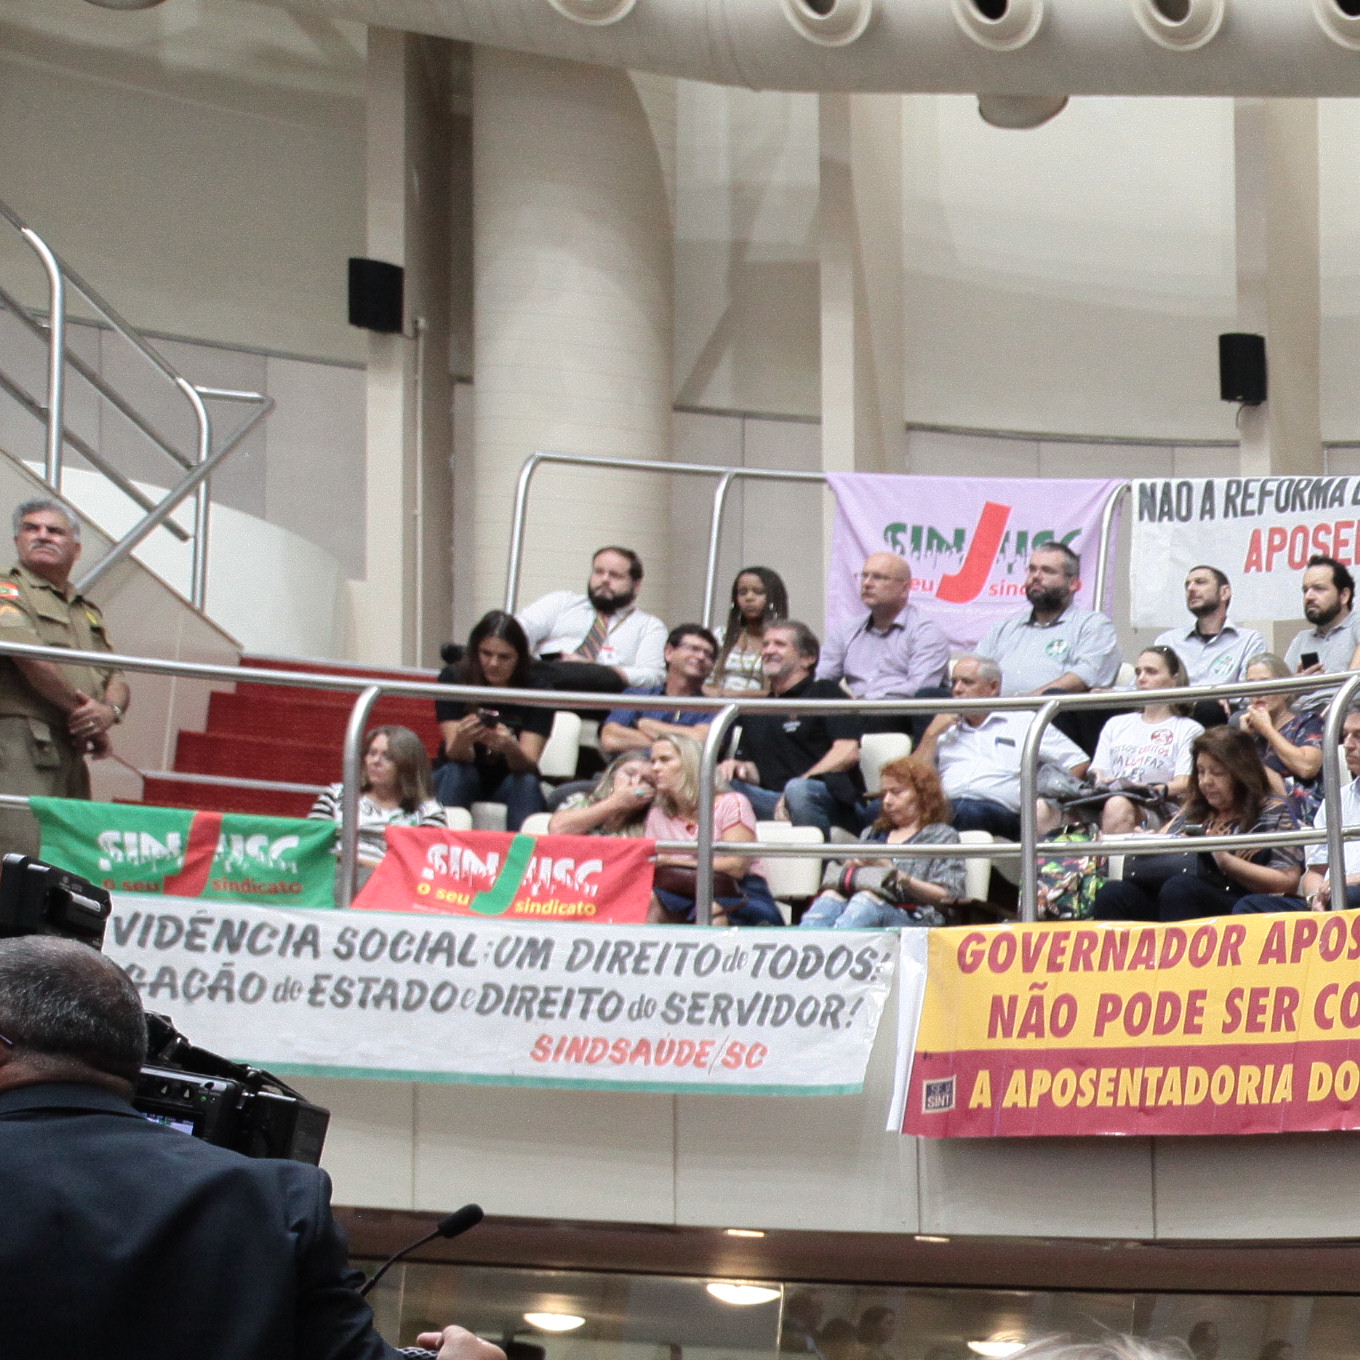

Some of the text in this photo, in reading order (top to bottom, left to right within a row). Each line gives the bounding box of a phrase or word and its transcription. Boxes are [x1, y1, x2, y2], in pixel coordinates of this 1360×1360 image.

[1199, 480, 1216, 521] A
[1223, 477, 1345, 519] REFORMA
[121, 880, 160, 892] seu
[212, 877, 303, 896] sindicato
[417, 882, 597, 917] o seu sindicato
[113, 910, 321, 961] VIDÊNCIA
[493, 934, 556, 971] UM
[565, 938, 722, 977] DIREITO
[722, 944, 748, 973] de
[957, 924, 1247, 974] GOVERNADOR
[307, 973, 459, 1014] ESTADO
[475, 981, 625, 1023] DIREITO
[628, 993, 658, 1022] do
[660, 989, 865, 1031] SERVIDOR!
[987, 981, 1078, 1040] NÃO
[1093, 989, 1208, 1038] PODE
[1222, 986, 1299, 1034] SER
[968, 1069, 992, 1109] A
[1002, 1063, 1294, 1109] APOSENTADORIA
[1307, 1060, 1360, 1102] DO
